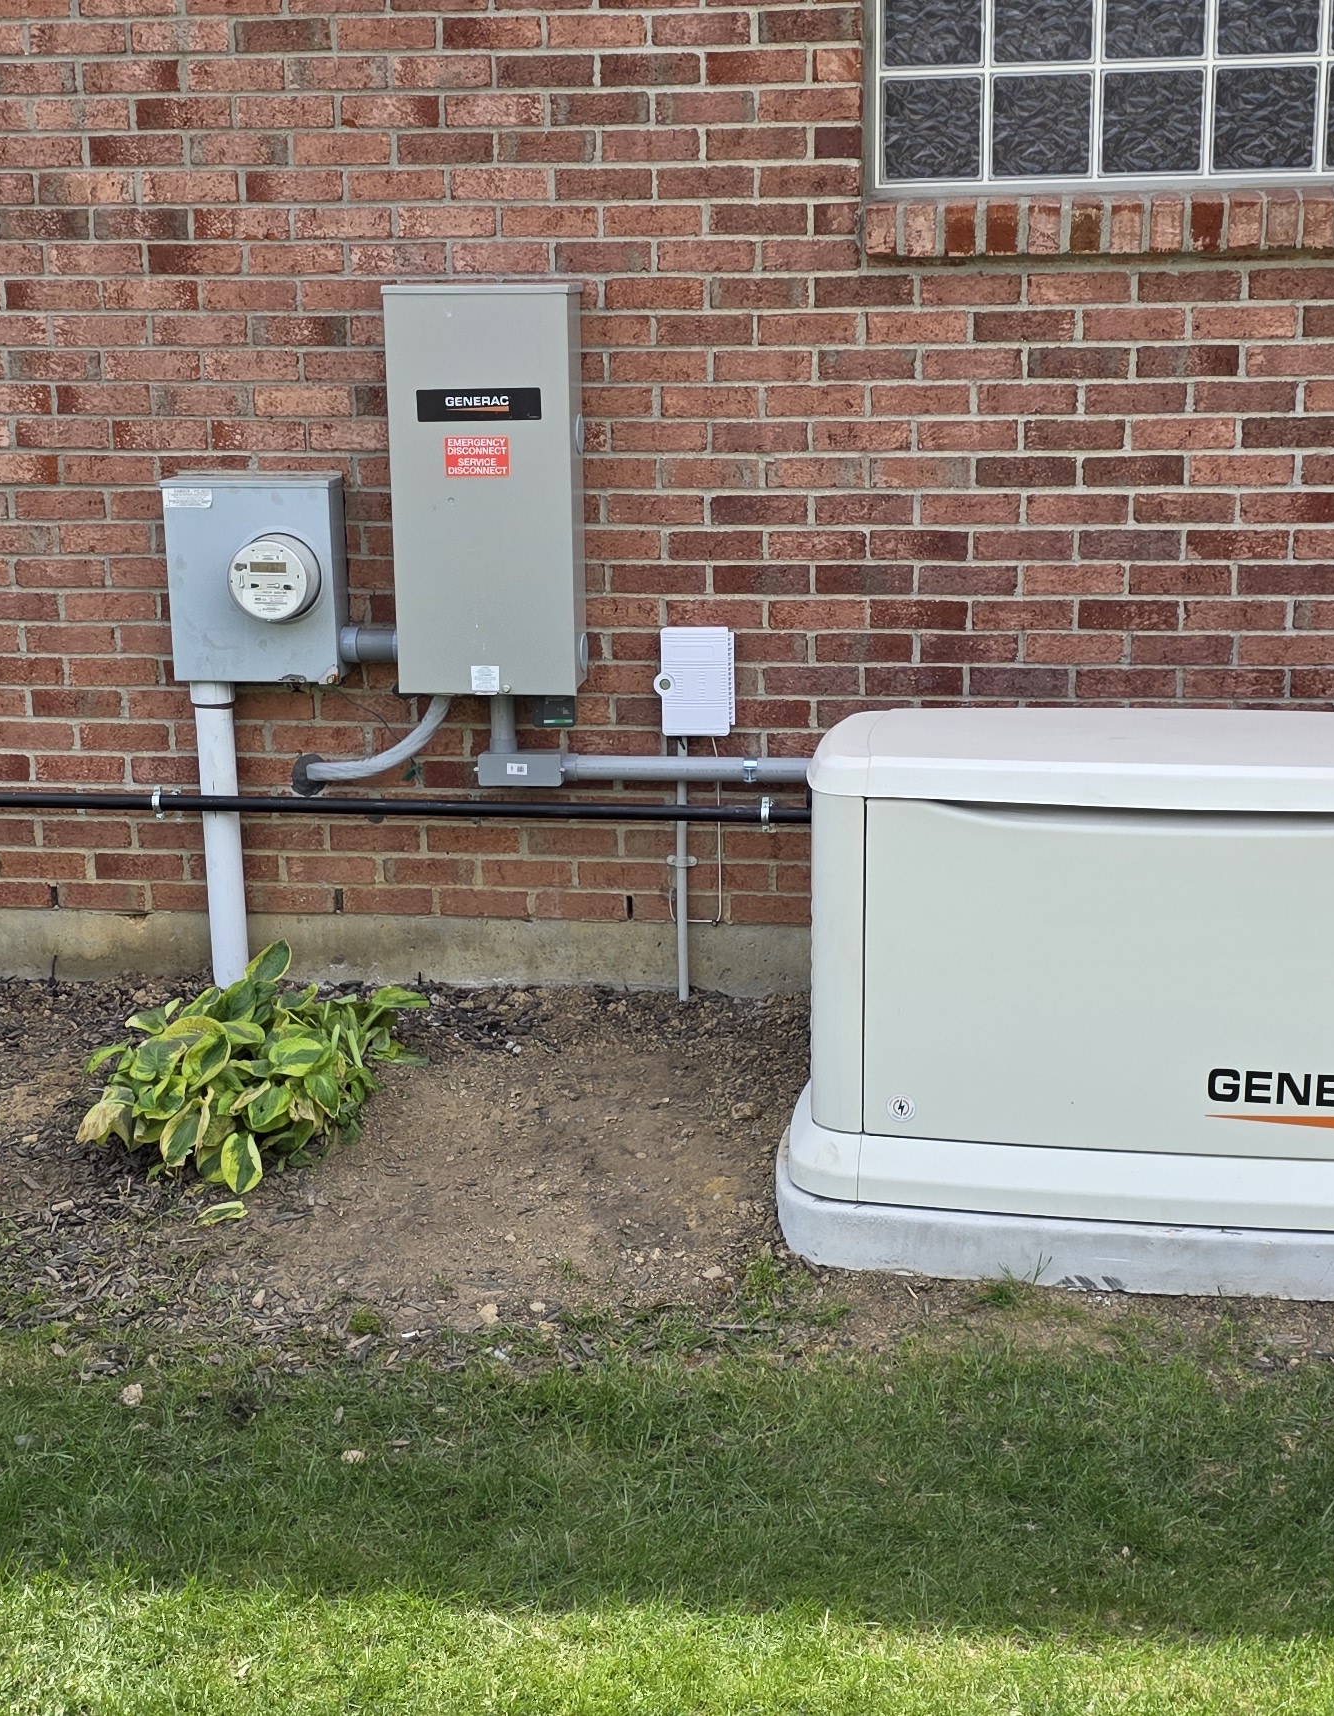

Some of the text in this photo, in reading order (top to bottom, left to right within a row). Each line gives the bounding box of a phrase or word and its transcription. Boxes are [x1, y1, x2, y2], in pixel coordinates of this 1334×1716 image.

[444, 396, 510, 407] GENERAC
[447, 438, 506, 447] EMERGENCY
[447, 447, 507, 455] DISCONNECT
[458, 458, 497, 466] SERVICE
[448, 466, 507, 475] DISCONNECT
